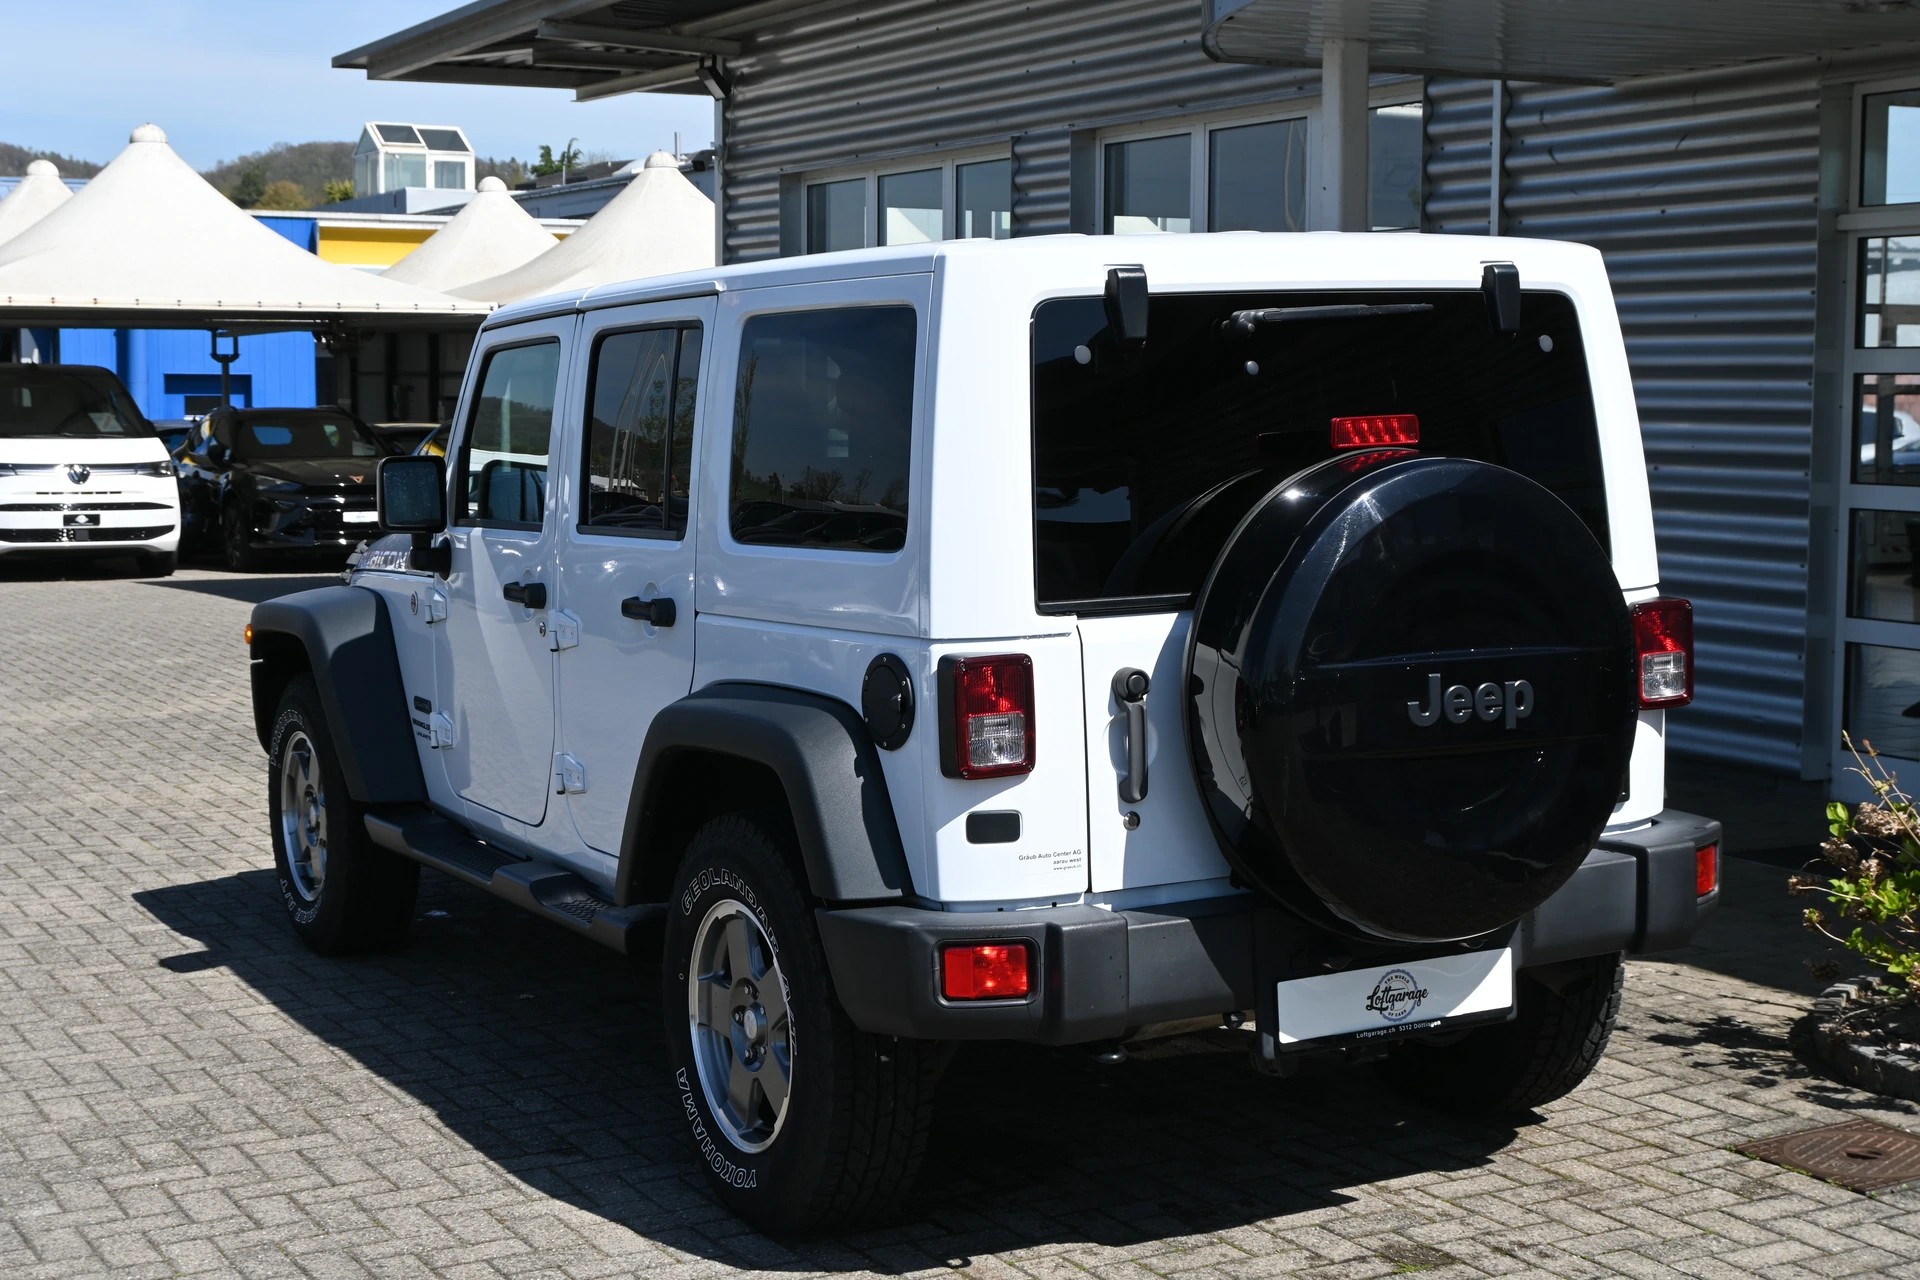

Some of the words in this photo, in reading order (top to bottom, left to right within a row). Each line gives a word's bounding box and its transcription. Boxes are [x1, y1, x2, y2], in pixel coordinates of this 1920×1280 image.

[1407, 673, 1535, 730] Jeep
[681, 867, 779, 954] GEOLANDAR
[1366, 985, 1428, 1015] Loftgarage
[1356, 1028, 1396, 1039] Loftgarage.ch
[1399, 1024, 1412, 1032] 5312
[676, 1067, 757, 1188] YOKOHAMA
